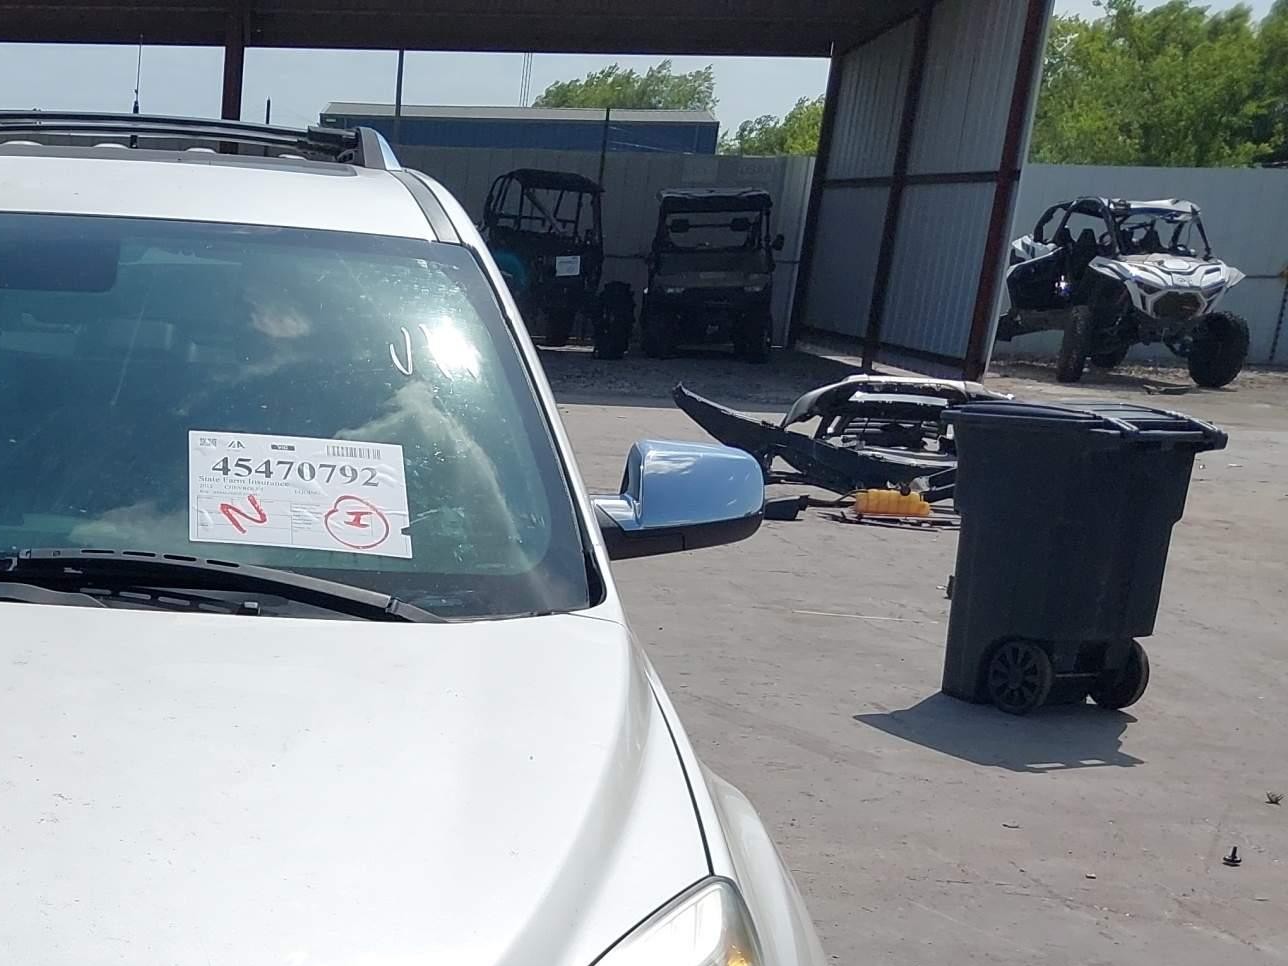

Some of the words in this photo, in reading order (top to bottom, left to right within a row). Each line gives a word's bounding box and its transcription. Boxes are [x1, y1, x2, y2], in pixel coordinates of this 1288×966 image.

[199, 475, 220, 483] State
[223, 476, 245, 485] Farm
[248, 478, 290, 487] Insurance
[211, 456, 379, 488] 45470792
